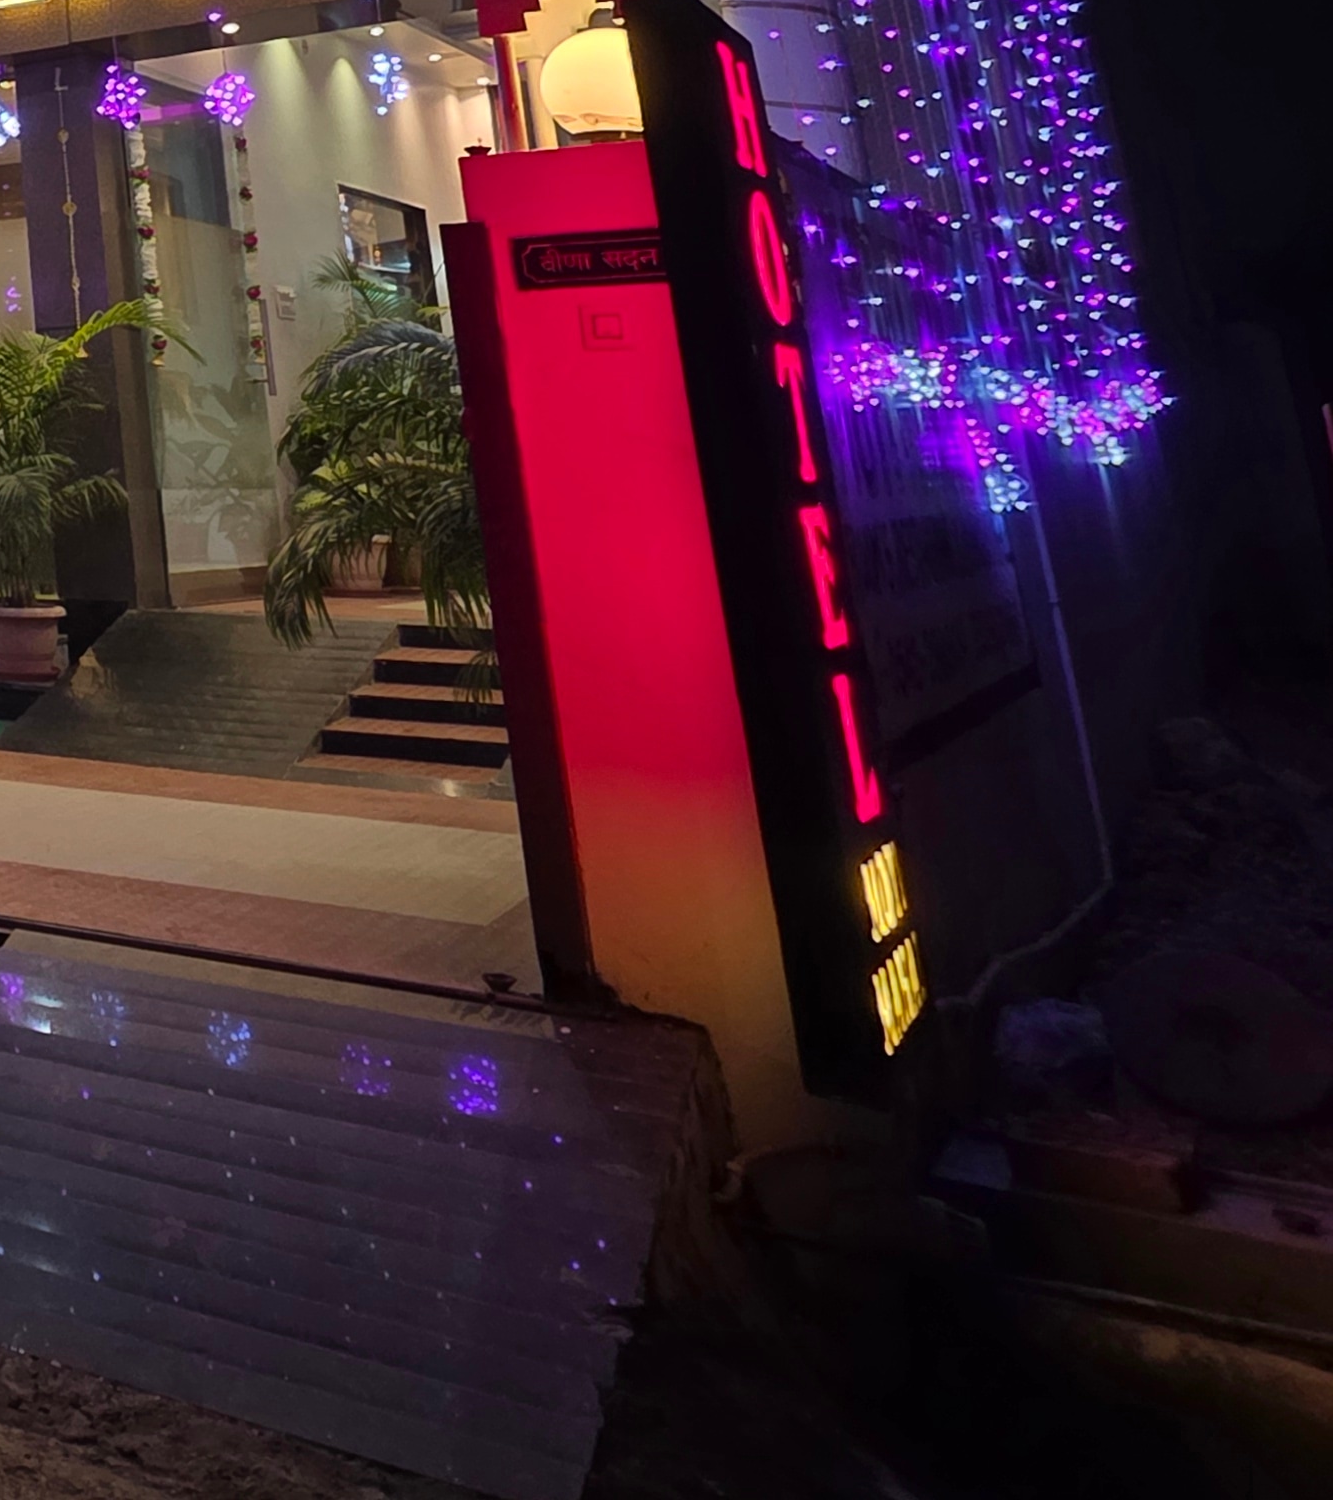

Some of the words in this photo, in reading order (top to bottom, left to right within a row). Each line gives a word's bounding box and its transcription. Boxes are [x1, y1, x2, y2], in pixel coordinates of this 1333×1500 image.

[539, 248, 593, 274] वीणा
[600, 247, 659, 272] सदन
[716, 40, 883, 825] HOTEL
